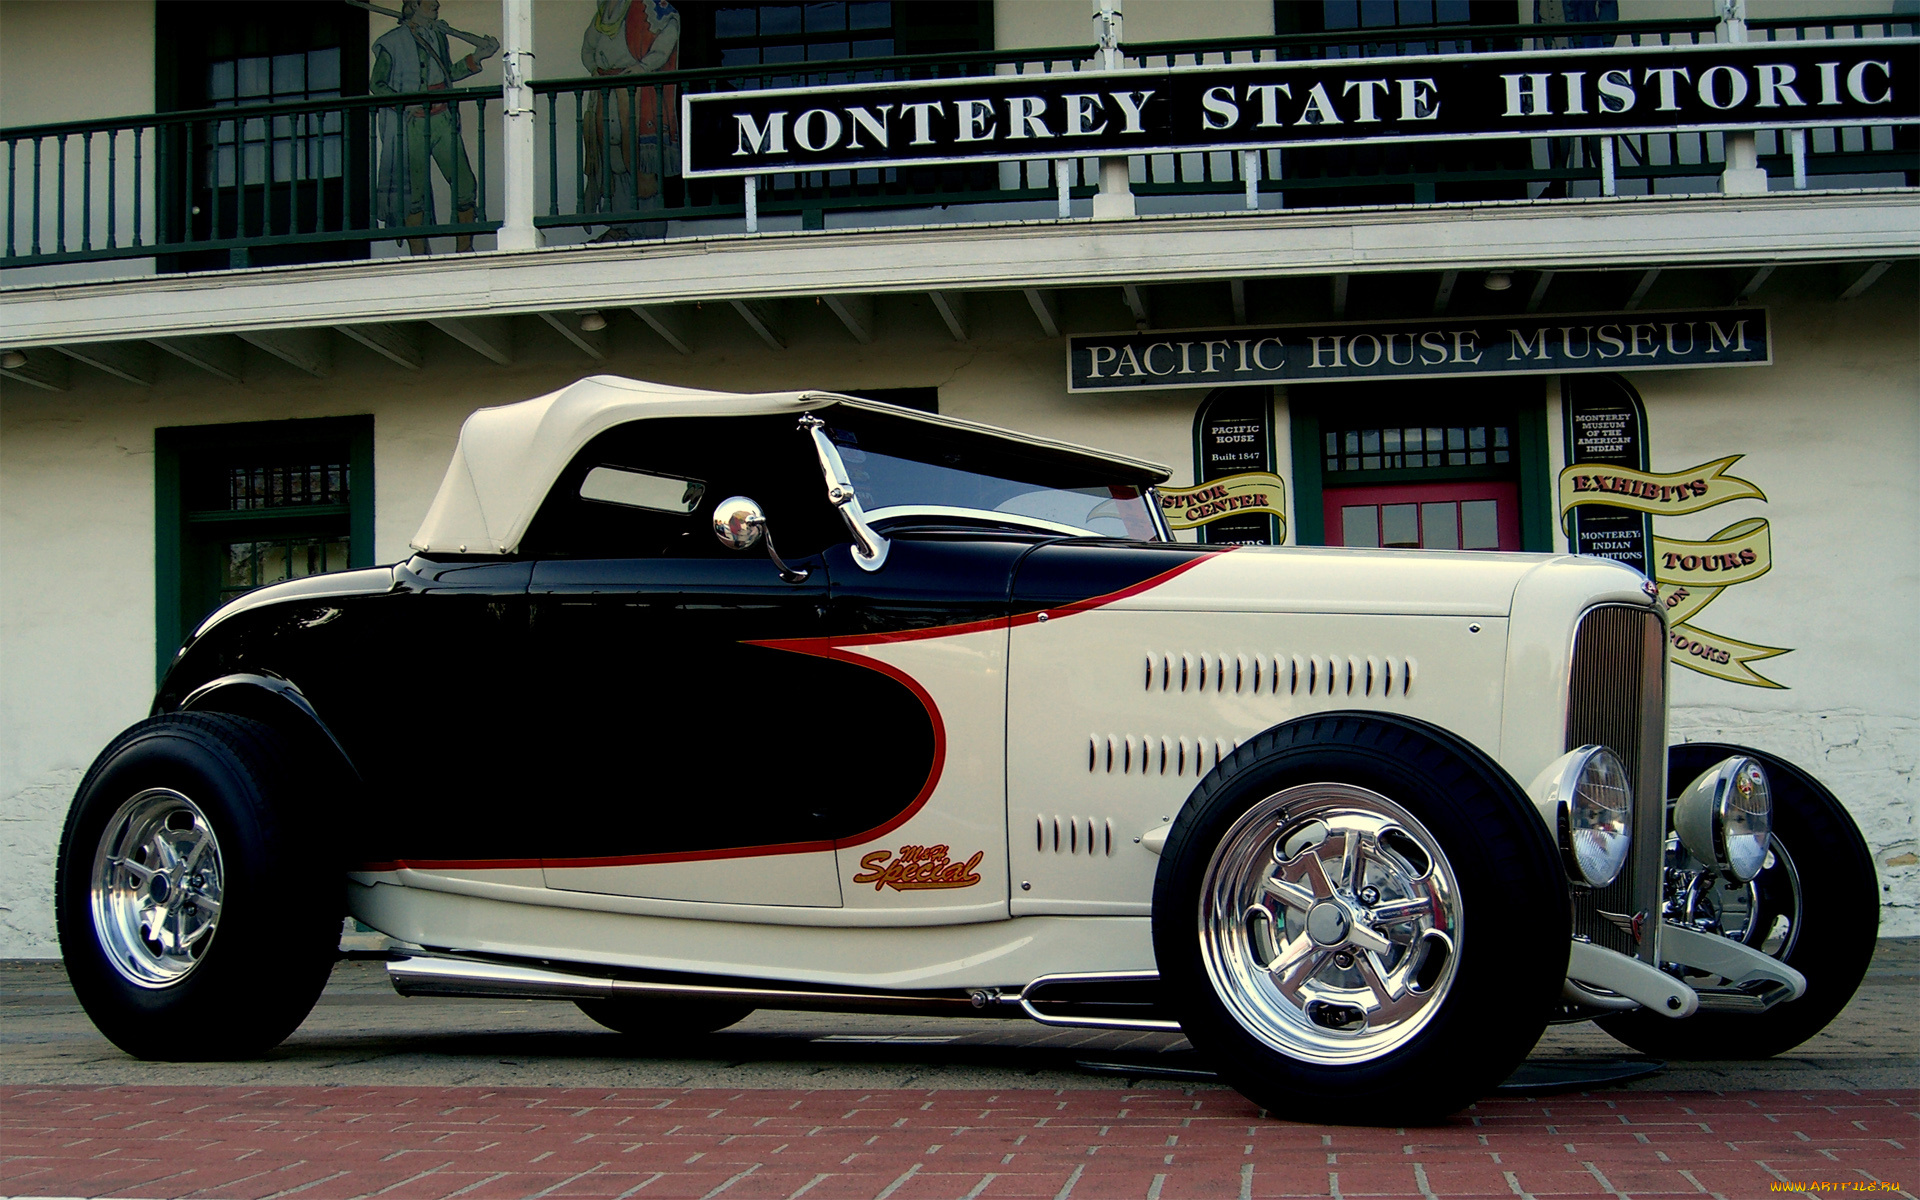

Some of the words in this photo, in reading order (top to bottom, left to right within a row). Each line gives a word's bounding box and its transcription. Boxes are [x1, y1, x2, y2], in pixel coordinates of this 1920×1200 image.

[731, 89, 1156, 157] MONTEREY
[1202, 76, 1440, 131] STATE
[1501, 60, 1893, 117] HISTORIC
[1086, 336, 1286, 379] PACIFIC
[1307, 330, 1483, 368] HOUSE
[1507, 319, 1752, 361] MUSEUM
[1575, 414, 1631, 422] MONTEREY
[1211, 425, 1260, 435] PACIFIC
[1582, 421, 1626, 429] MUSEUM
[1216, 435, 1255, 443] HOUSE
[1578, 437, 1631, 445] AMERICAN
[1211, 453, 1236, 461] Built
[1238, 452, 1260, 460] 1847
[1572, 475, 1709, 503] EXHIBITS
[1159, 484, 1229, 509] SITOR
[1185, 493, 1269, 521] CENTER
[1592, 541, 1631, 550] INDIAN
[1582, 551, 1642, 560] ADITIONS
[1662, 547, 1757, 571] TOURS
[853, 850, 984, 892] Special
